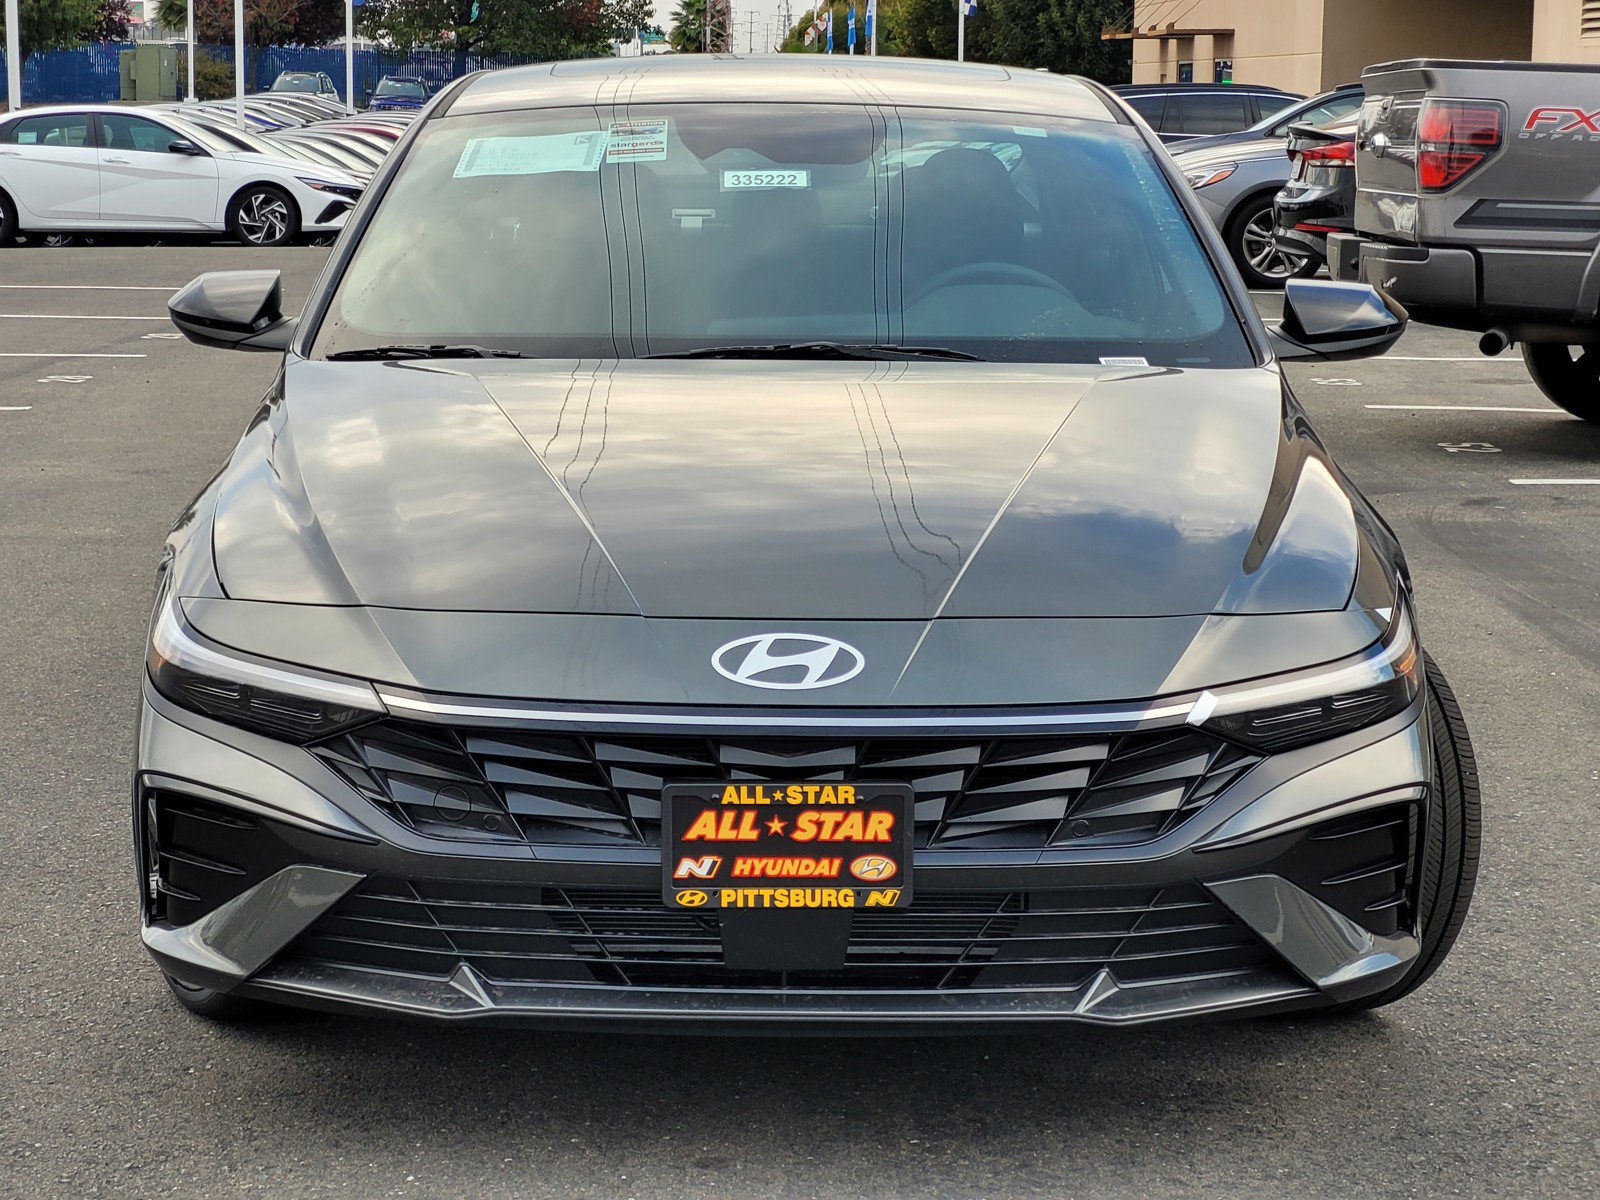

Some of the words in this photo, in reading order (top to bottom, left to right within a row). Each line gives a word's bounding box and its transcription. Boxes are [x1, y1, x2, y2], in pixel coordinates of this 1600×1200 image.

[1522, 107, 1600, 133] FX
[731, 174, 797, 185] 335222
[721, 786, 771, 805] ALL
[786, 786, 856, 805] STAR
[681, 810, 760, 841] ALL
[790, 810, 894, 842] STAR
[732, 857, 842, 877] HYUNDAI
[721, 889, 855, 908] PITTSBURG
